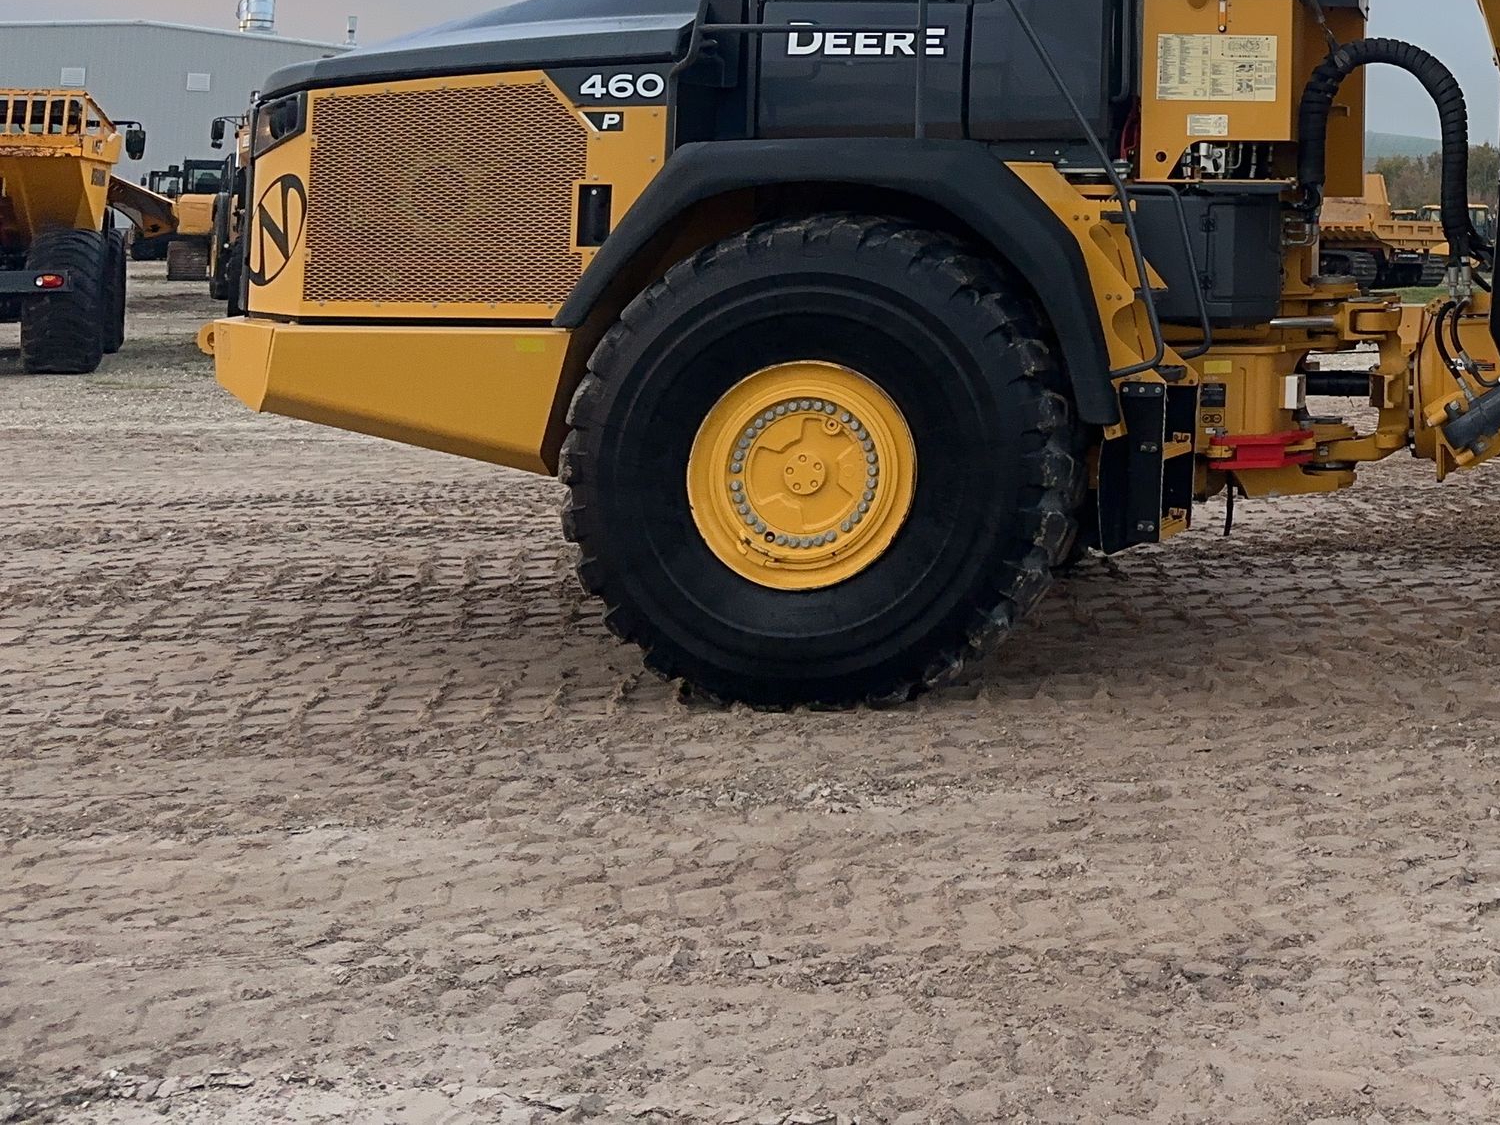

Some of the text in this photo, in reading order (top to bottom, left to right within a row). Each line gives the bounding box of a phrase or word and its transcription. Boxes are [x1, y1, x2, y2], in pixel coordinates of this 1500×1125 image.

[787, 22, 946, 55] DEERE
[579, 73, 665, 98] 460
[601, 113, 621, 130] P
